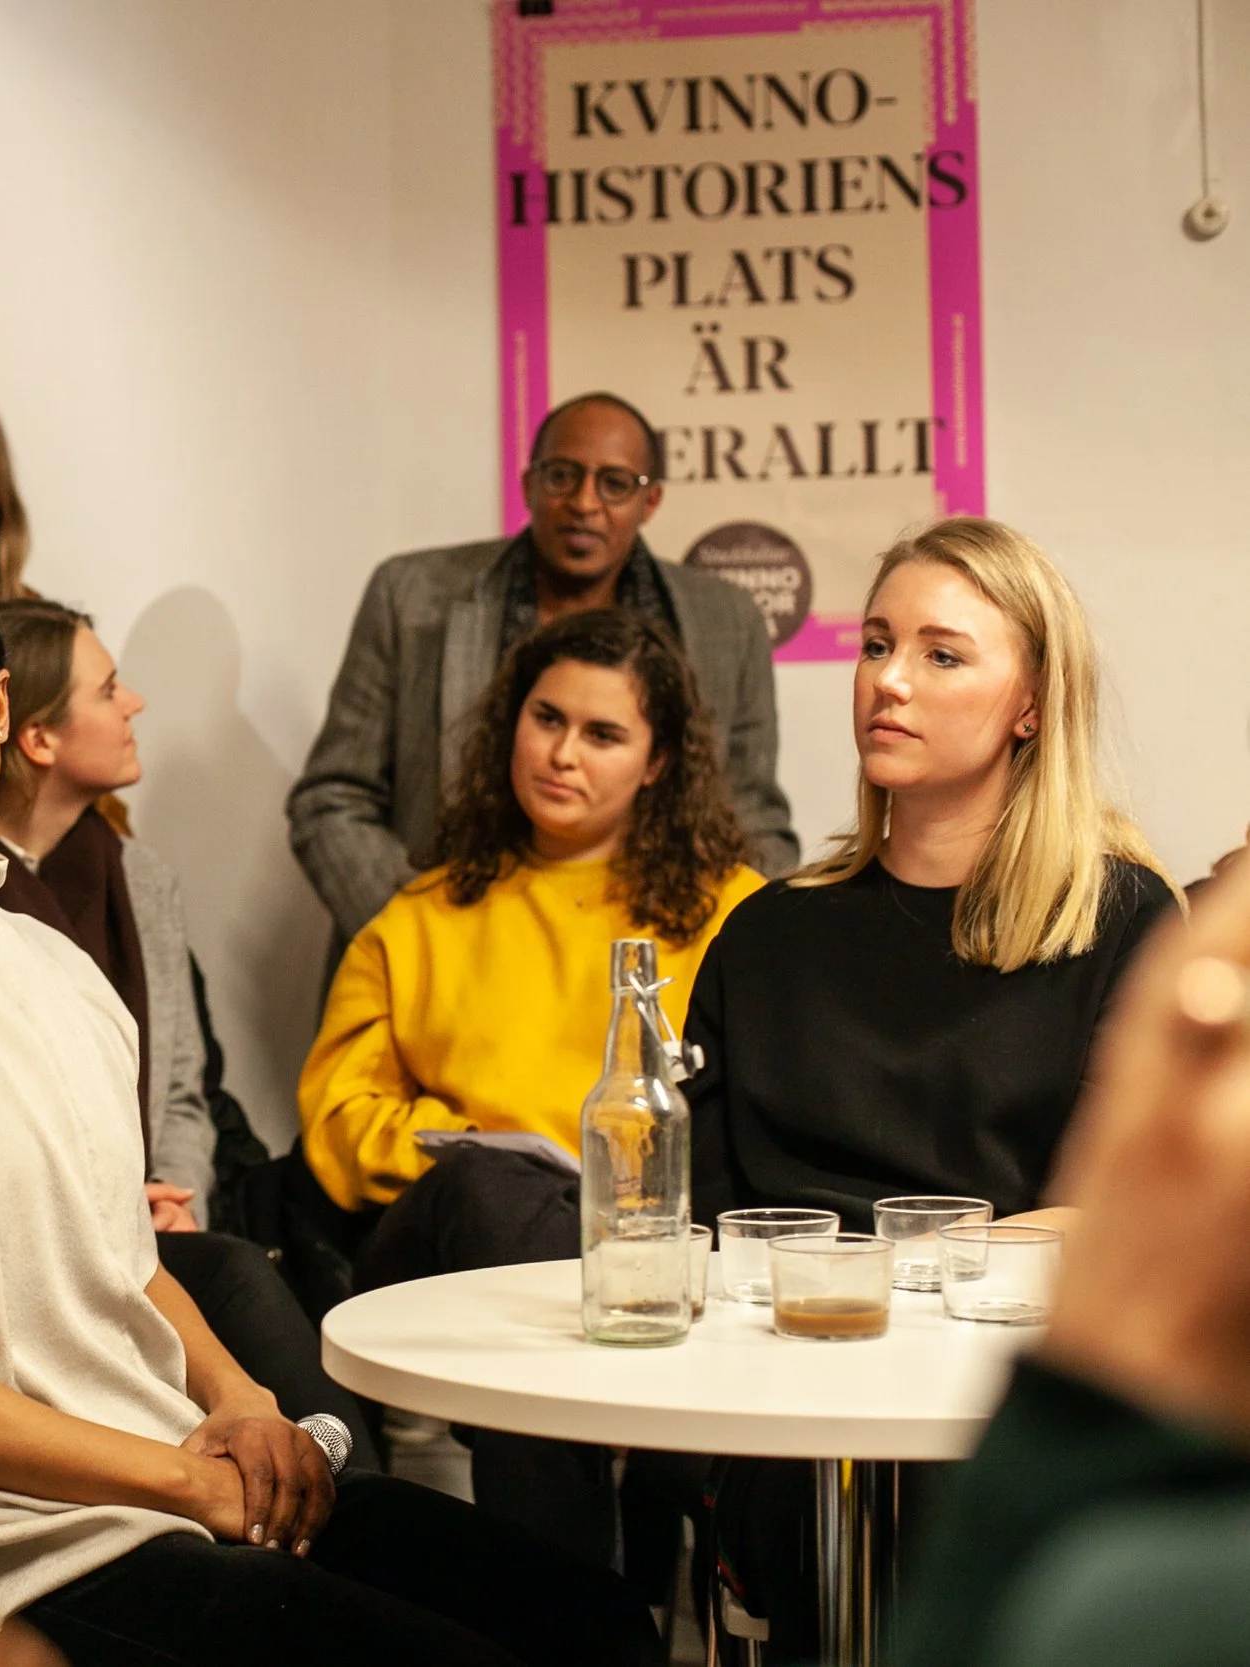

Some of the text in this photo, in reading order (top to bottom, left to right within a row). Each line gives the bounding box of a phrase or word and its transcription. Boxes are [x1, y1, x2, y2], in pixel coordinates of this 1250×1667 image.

[570, 69, 899, 139] KVINNO-
[508, 151, 968, 229] HISTORIENS
[622, 245, 857, 311] PLATS
[682, 322, 793, 394] ÄR
[654, 417, 948, 484] ERALLT
